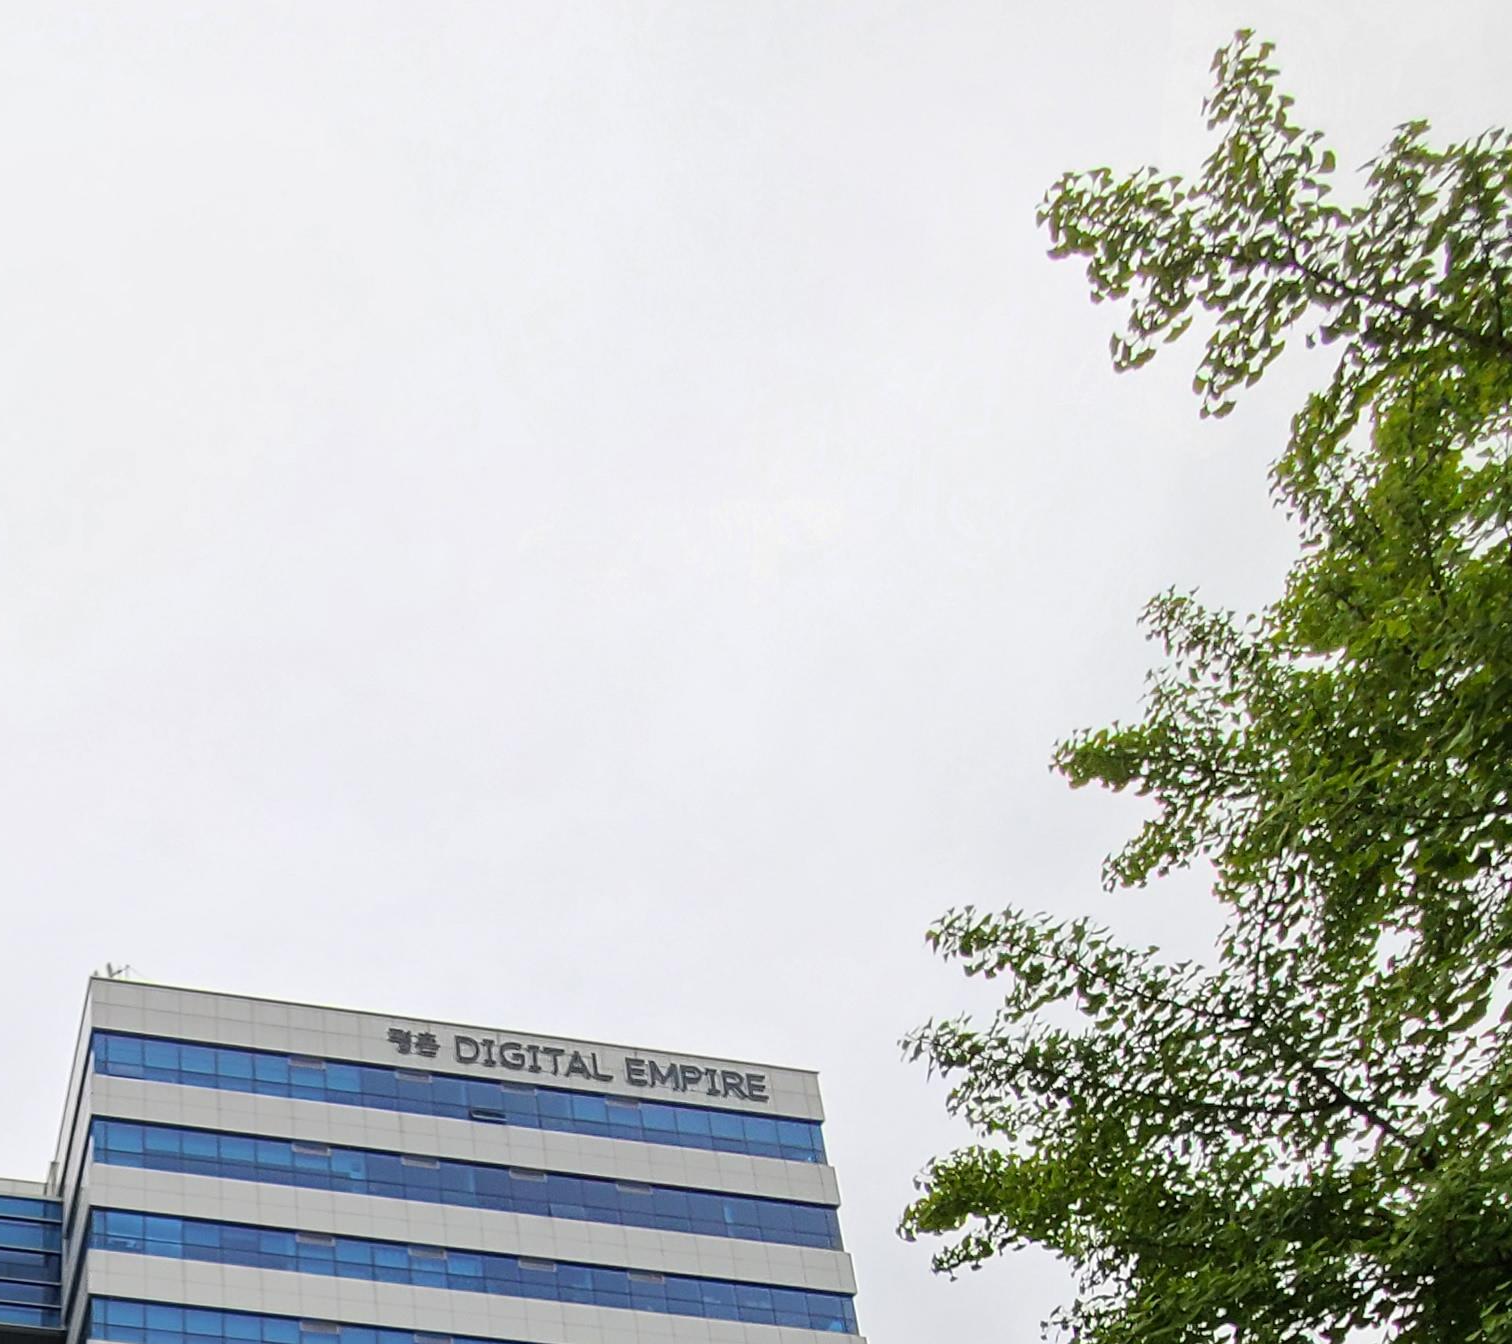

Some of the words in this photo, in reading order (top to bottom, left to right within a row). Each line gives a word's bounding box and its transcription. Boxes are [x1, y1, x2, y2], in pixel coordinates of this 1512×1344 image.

[388, 1027, 440, 1057] 평촌
[455, 1035, 613, 1082] DIGITAL
[624, 1056, 770, 1101] EMPIRE
